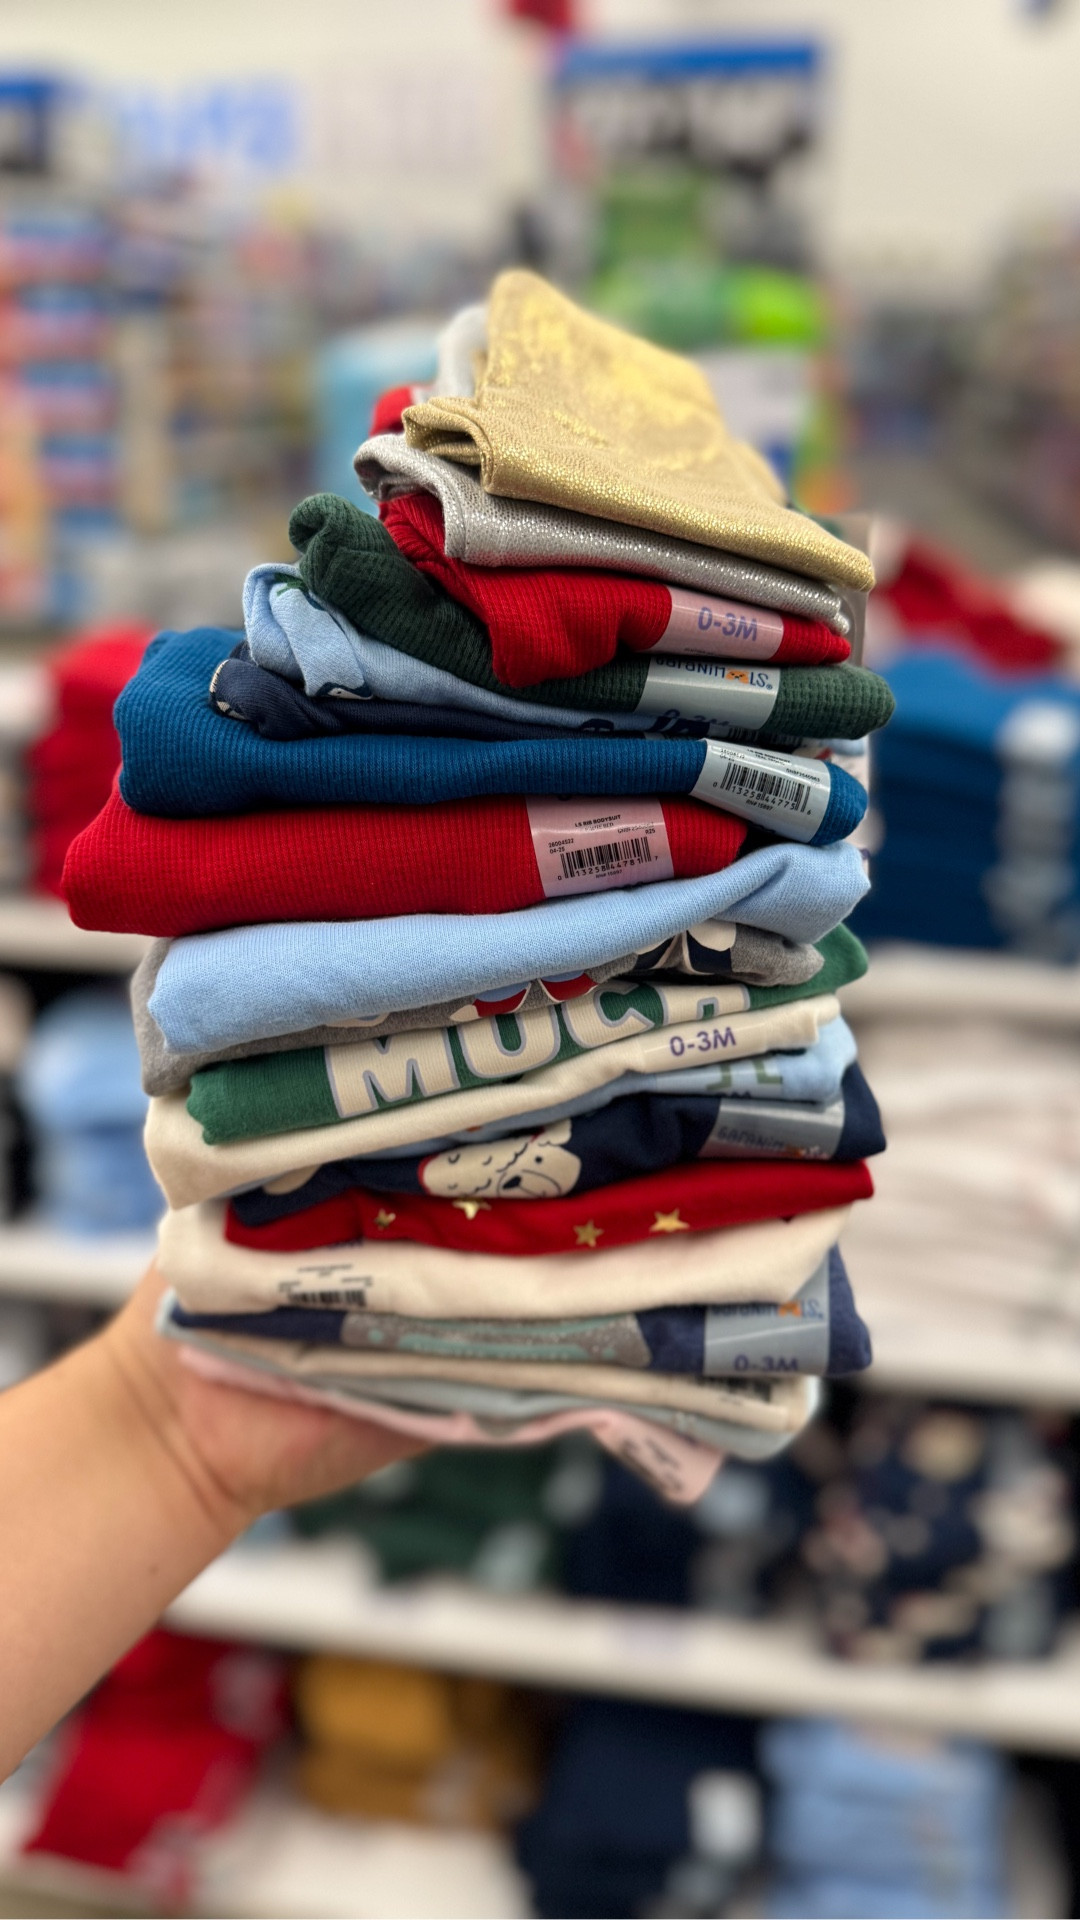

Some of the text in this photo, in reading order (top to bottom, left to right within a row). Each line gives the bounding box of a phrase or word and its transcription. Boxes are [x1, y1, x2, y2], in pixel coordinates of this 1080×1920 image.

[698, 607, 758, 641] 0-3M
[732, 786, 761, 800] 13258
[764, 795, 795, 810] 44775
[593, 814, 621, 825] BODYSUIT
[575, 865, 606, 877] 13258
[610, 858, 641, 870] 44781
[669, 1027, 737, 1057] 0-3M
[734, 1354, 798, 1372] 0-3M
